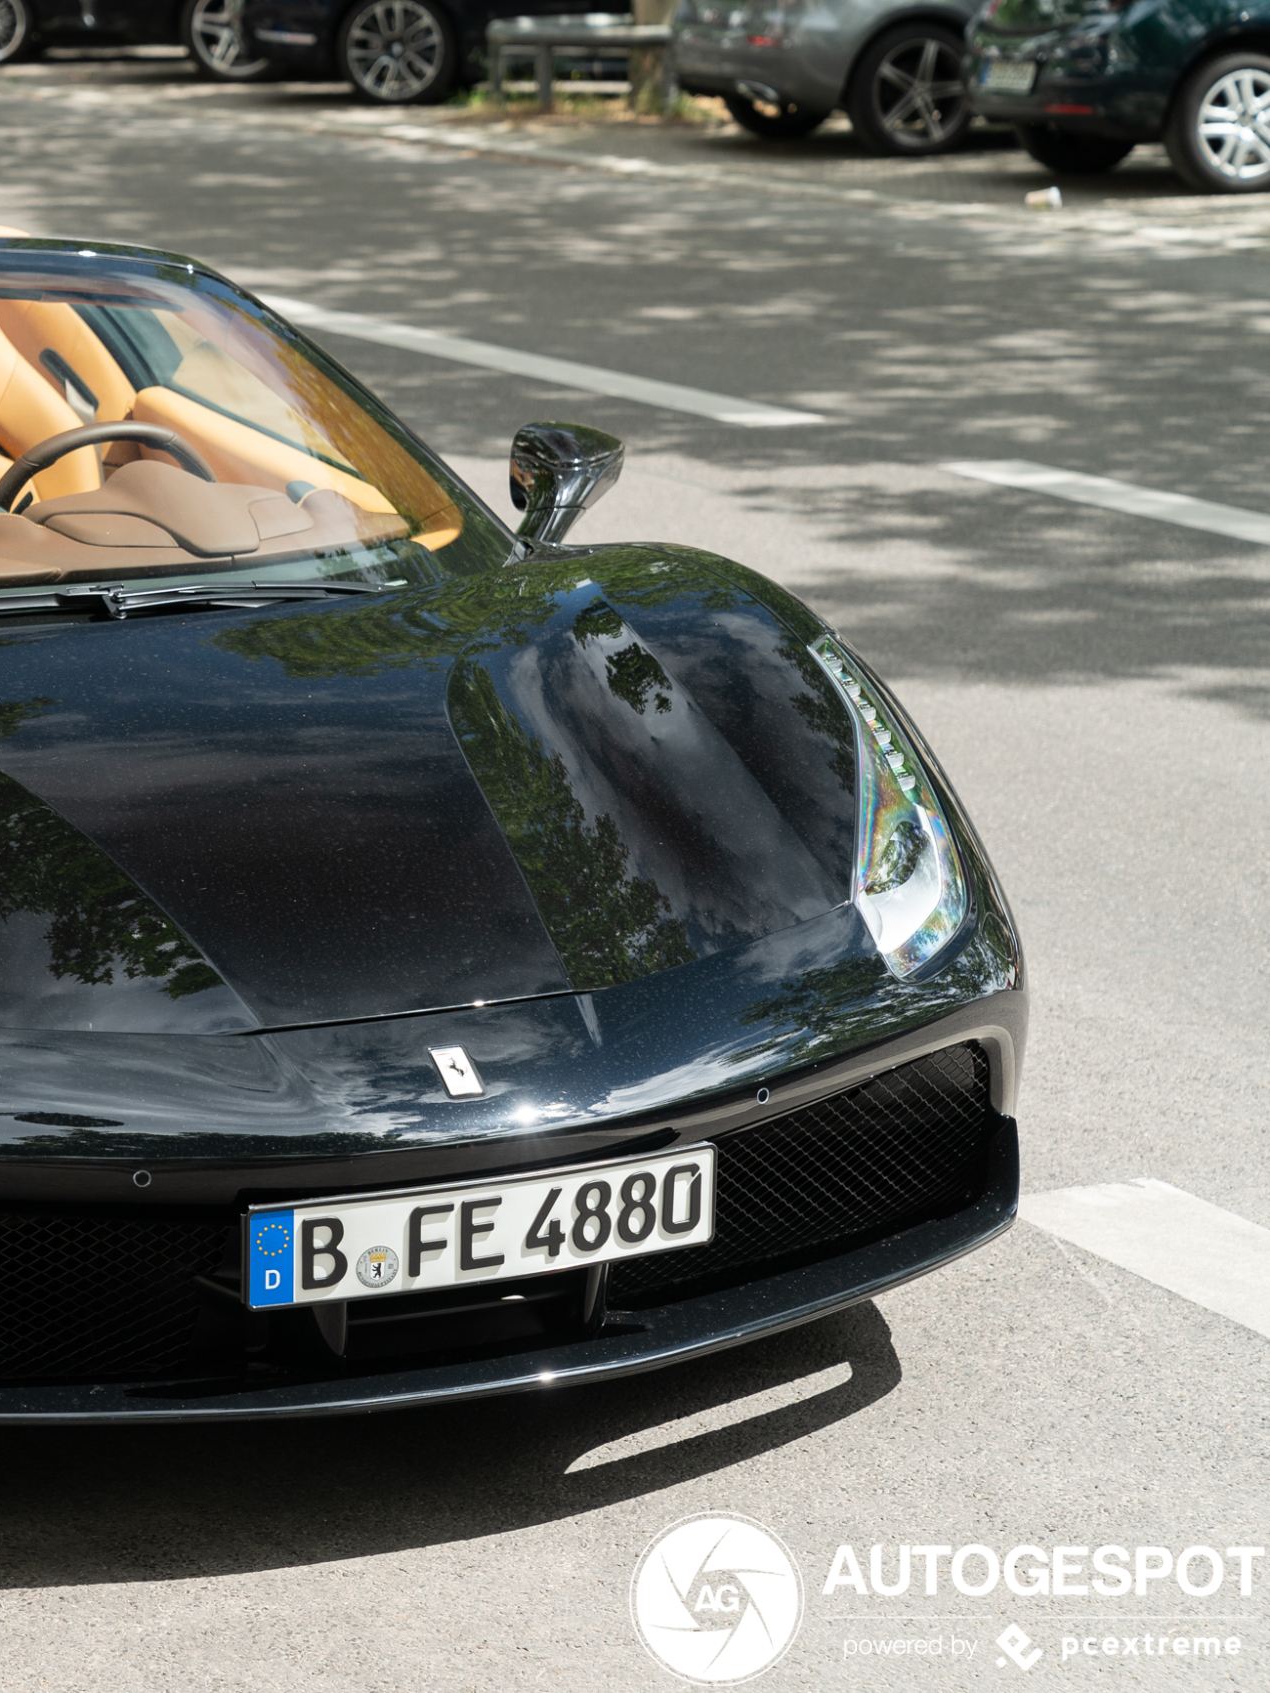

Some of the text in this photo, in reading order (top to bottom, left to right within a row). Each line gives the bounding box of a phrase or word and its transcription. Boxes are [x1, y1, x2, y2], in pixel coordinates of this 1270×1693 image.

[302, 1162, 702, 1290] B FE 4880
[265, 1269, 281, 1290] D
